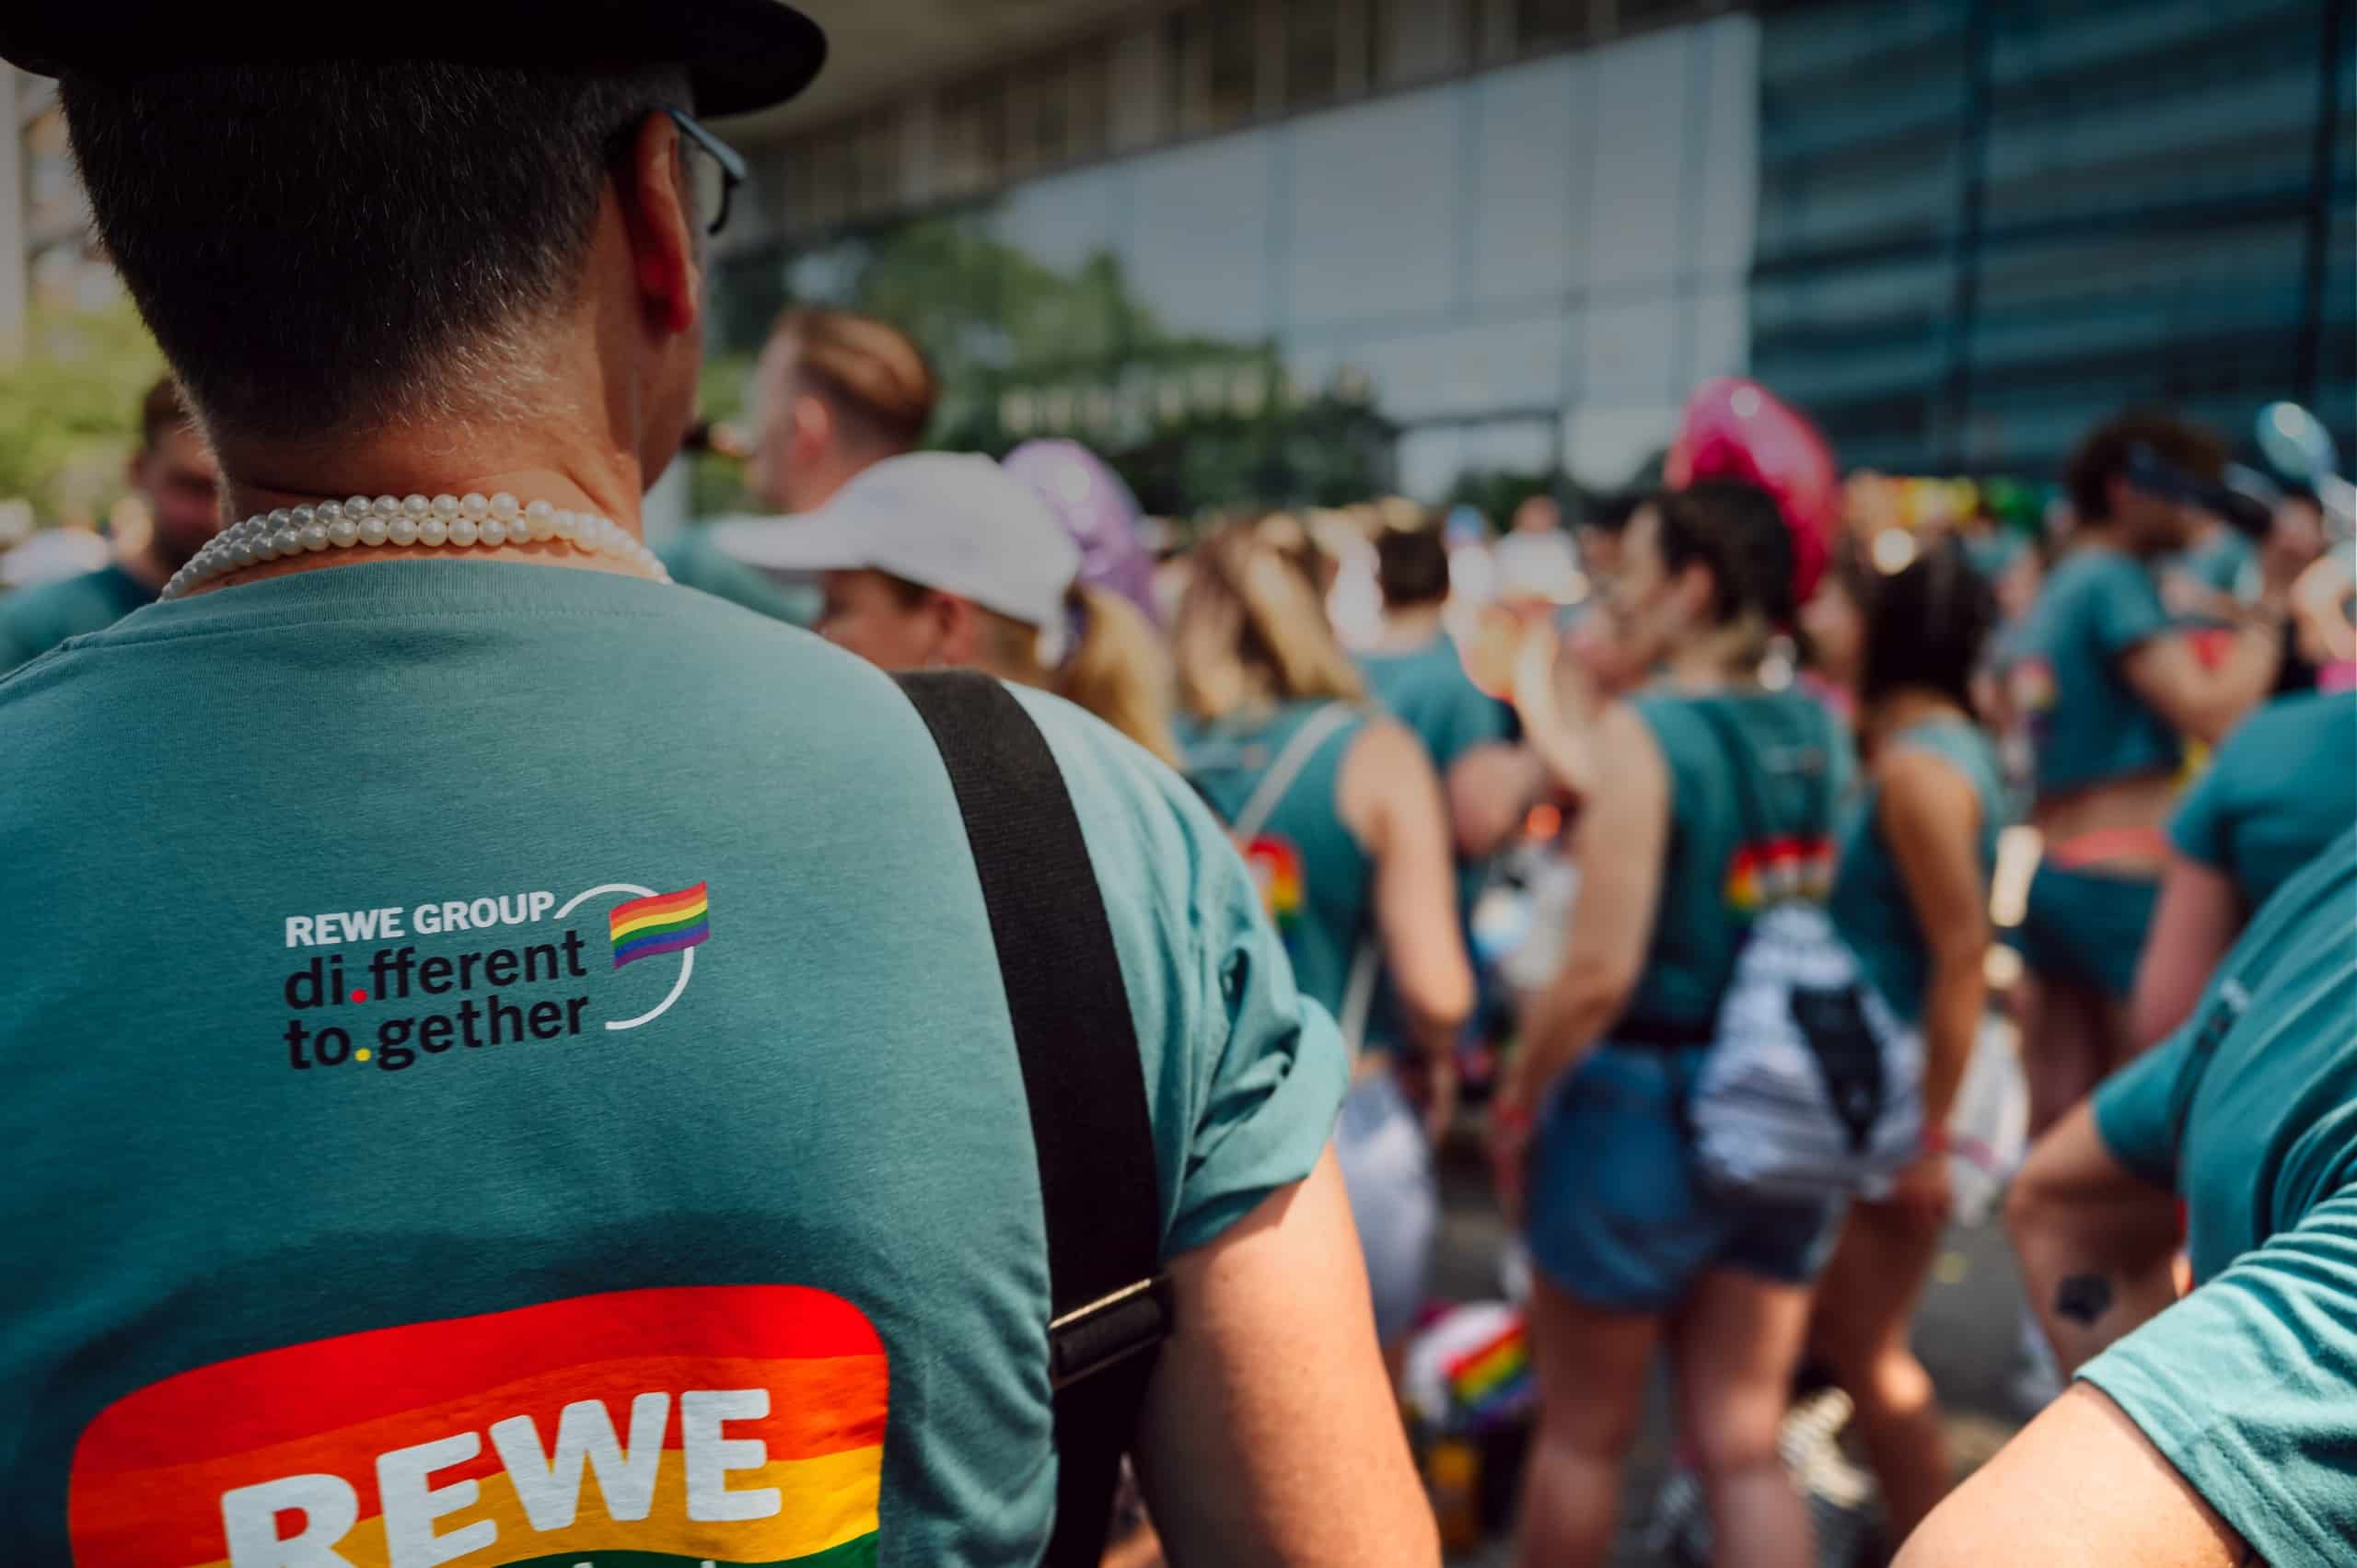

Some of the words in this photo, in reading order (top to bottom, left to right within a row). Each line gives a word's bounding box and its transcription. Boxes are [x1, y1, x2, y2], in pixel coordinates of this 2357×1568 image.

[286, 907, 405, 947] REWE
[412, 890, 555, 935] GROUP
[284, 929, 587, 1011] di.fferent
[282, 994, 590, 1072] to.gether
[222, 1388, 782, 1568] REWE
